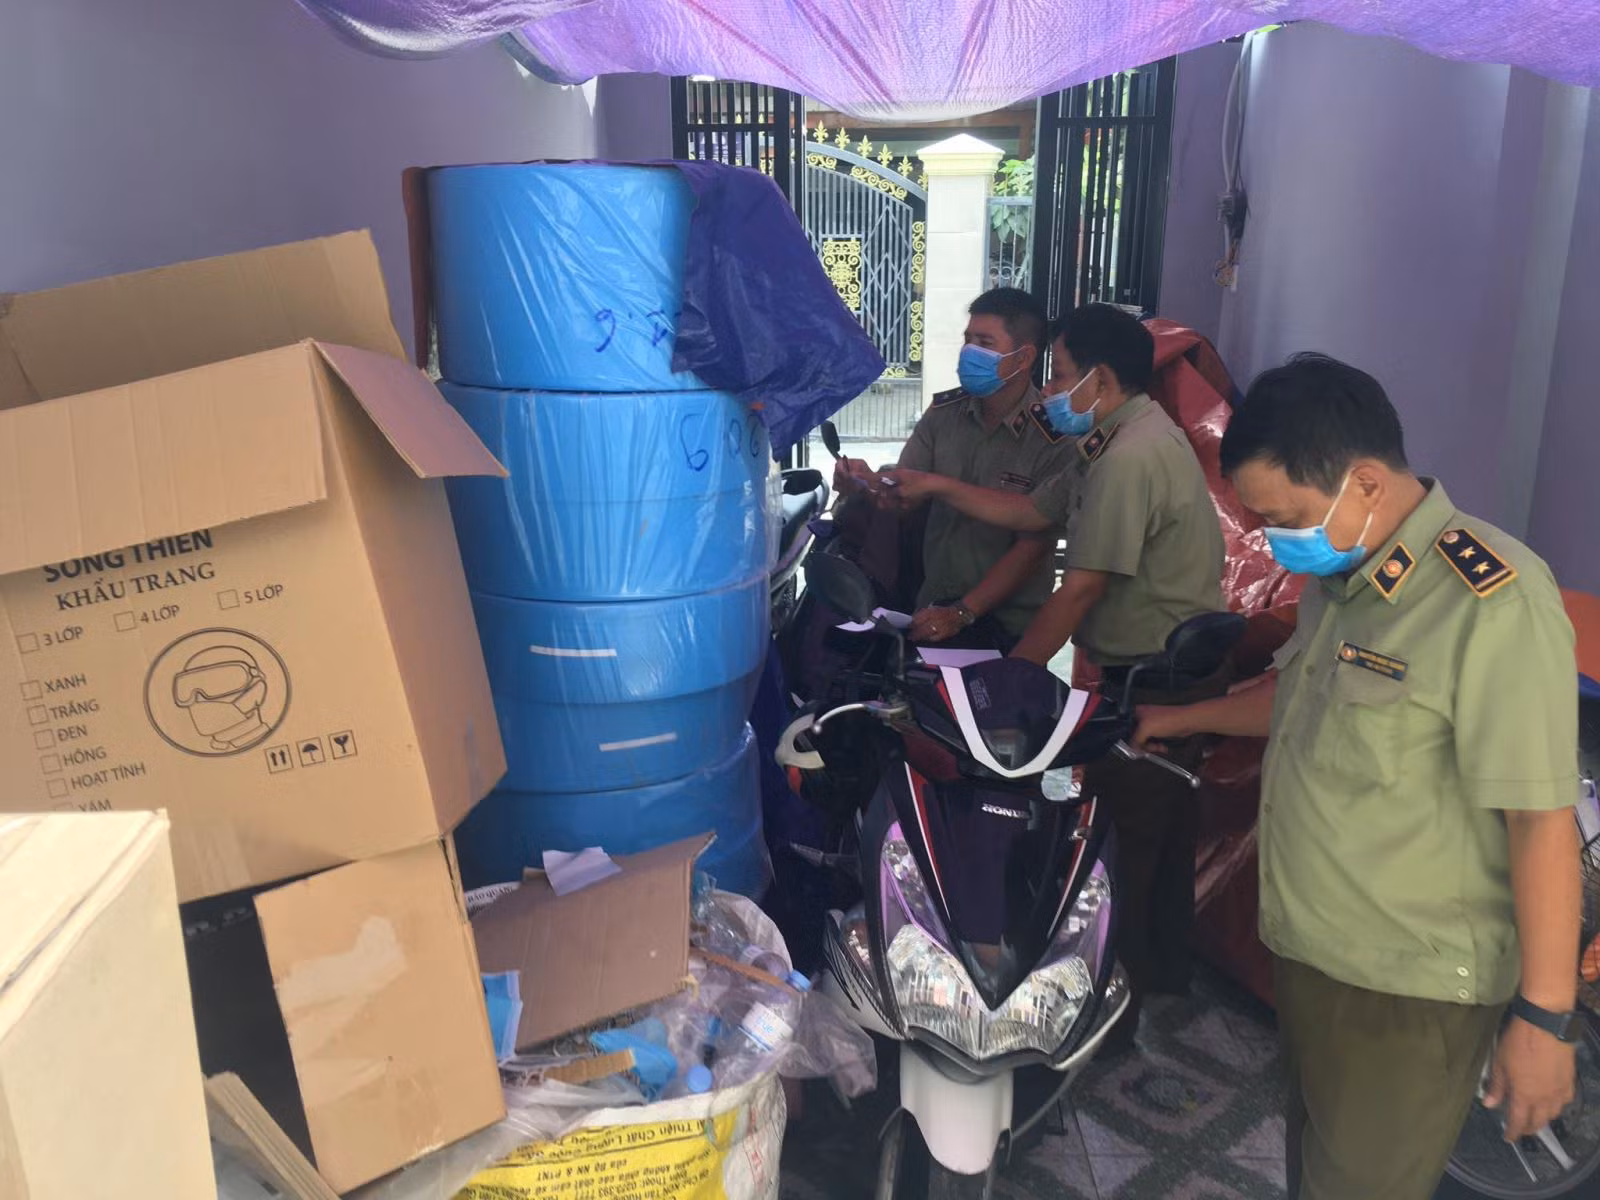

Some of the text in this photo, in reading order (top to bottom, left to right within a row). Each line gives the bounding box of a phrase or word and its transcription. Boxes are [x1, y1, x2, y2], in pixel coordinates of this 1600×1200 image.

[130, 562, 215, 594] TRANG
[43, 584, 284, 646] 3 LỚP 4 LỚP 5 LỚP
[44, 673, 87, 693] XANH
[57, 725, 88, 741] ĐEN
[627, 1130, 656, 1144] Chất
[659, 1121, 692, 1136] Thiện
